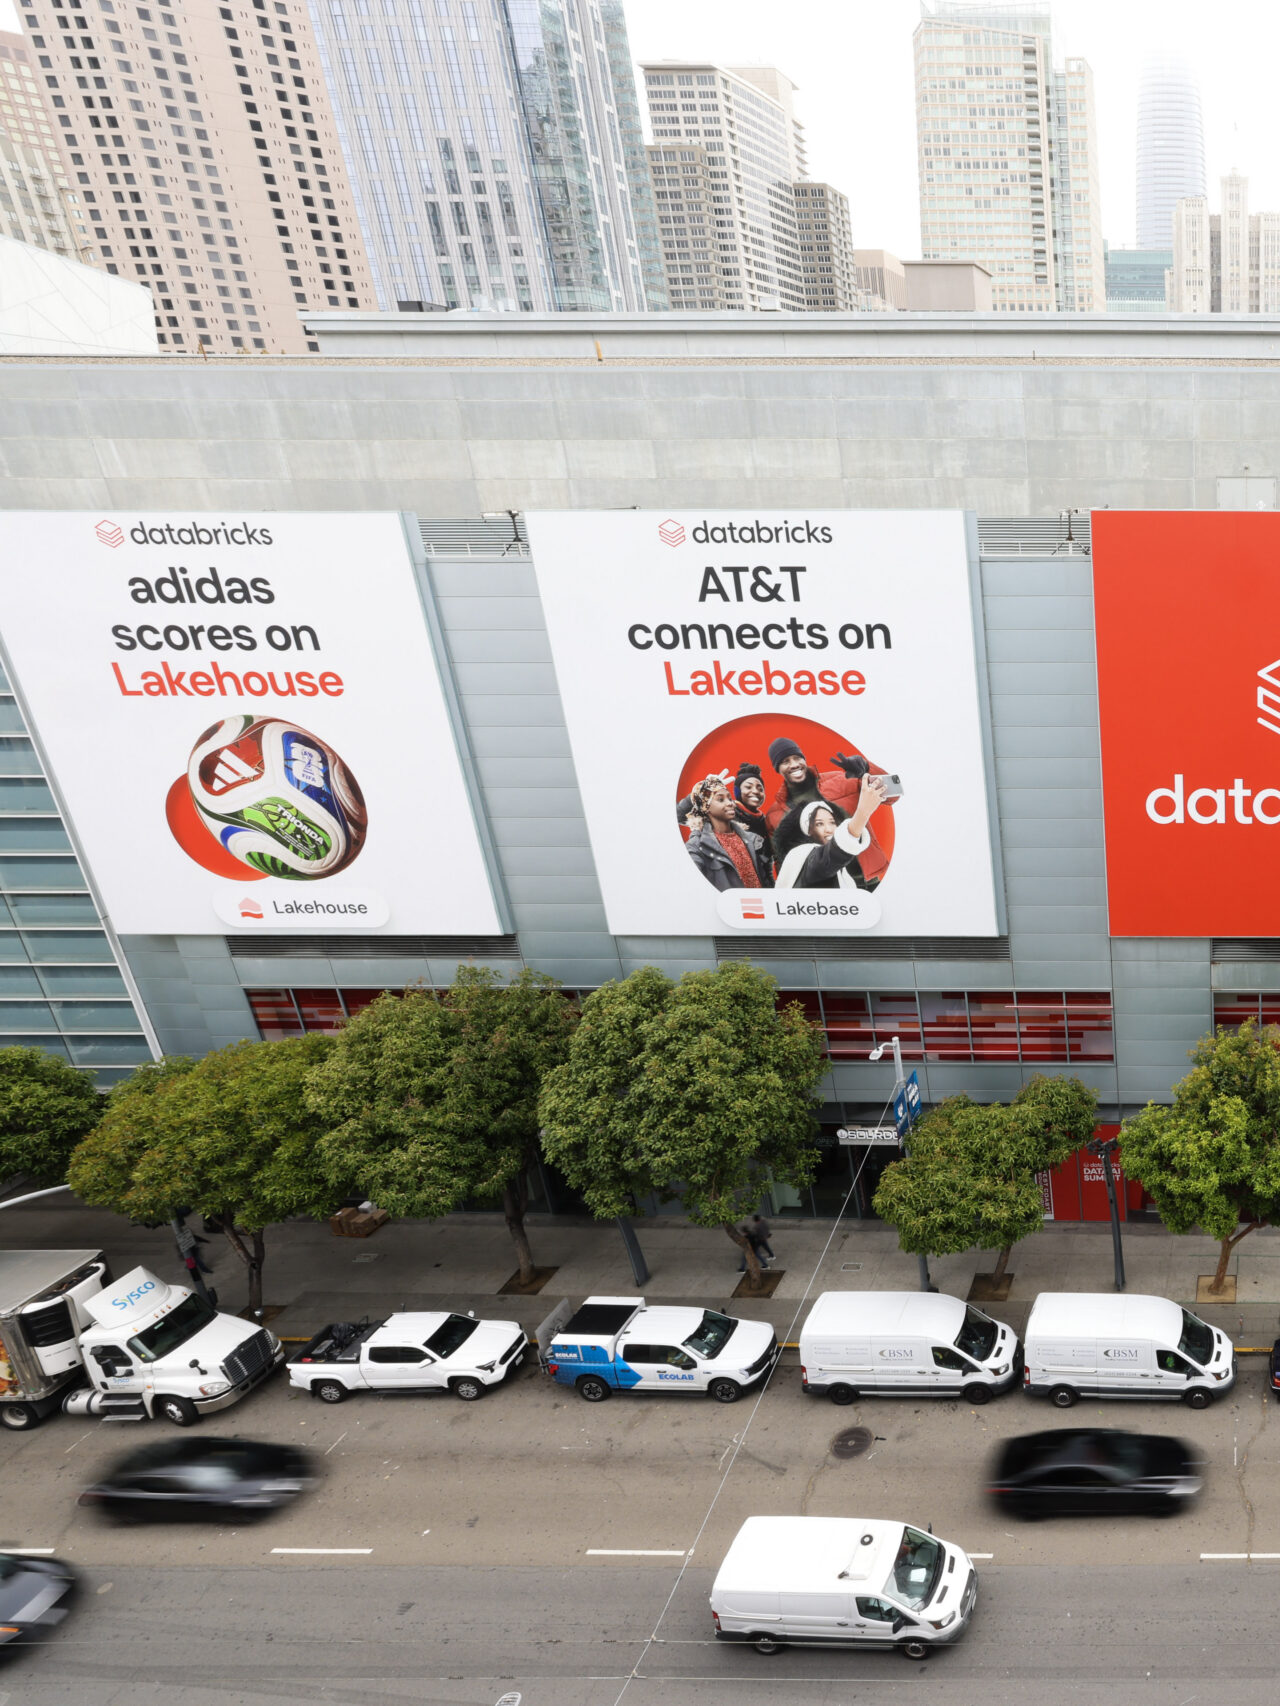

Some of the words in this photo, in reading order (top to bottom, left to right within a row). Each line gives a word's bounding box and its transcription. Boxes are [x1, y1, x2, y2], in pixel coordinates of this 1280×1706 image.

[130, 521, 273, 546] databricks
[692, 519, 833, 544] databricks
[128, 566, 275, 605] adidas
[698, 565, 807, 603] AT&T
[111, 624, 258, 652] scores
[265, 624, 321, 652] on
[627, 617, 829, 650] connects
[838, 623, 892, 650] on
[111, 661, 344, 697] Lakehouse
[663, 659, 866, 696] Lakebase
[301, 773, 317, 783] FIFA
[276, 804, 325, 845] TRIONDA
[273, 900, 368, 914] Lakehouse
[776, 901, 859, 916] Lakebase
[1083, 1174, 1121, 1182] SUMIT
[111, 1280, 156, 1311] Sysco
[888, 1349, 913, 1358] BSM
[1113, 1349, 1138, 1358] BSM
[658, 1373, 695, 1381] ECOLAB
